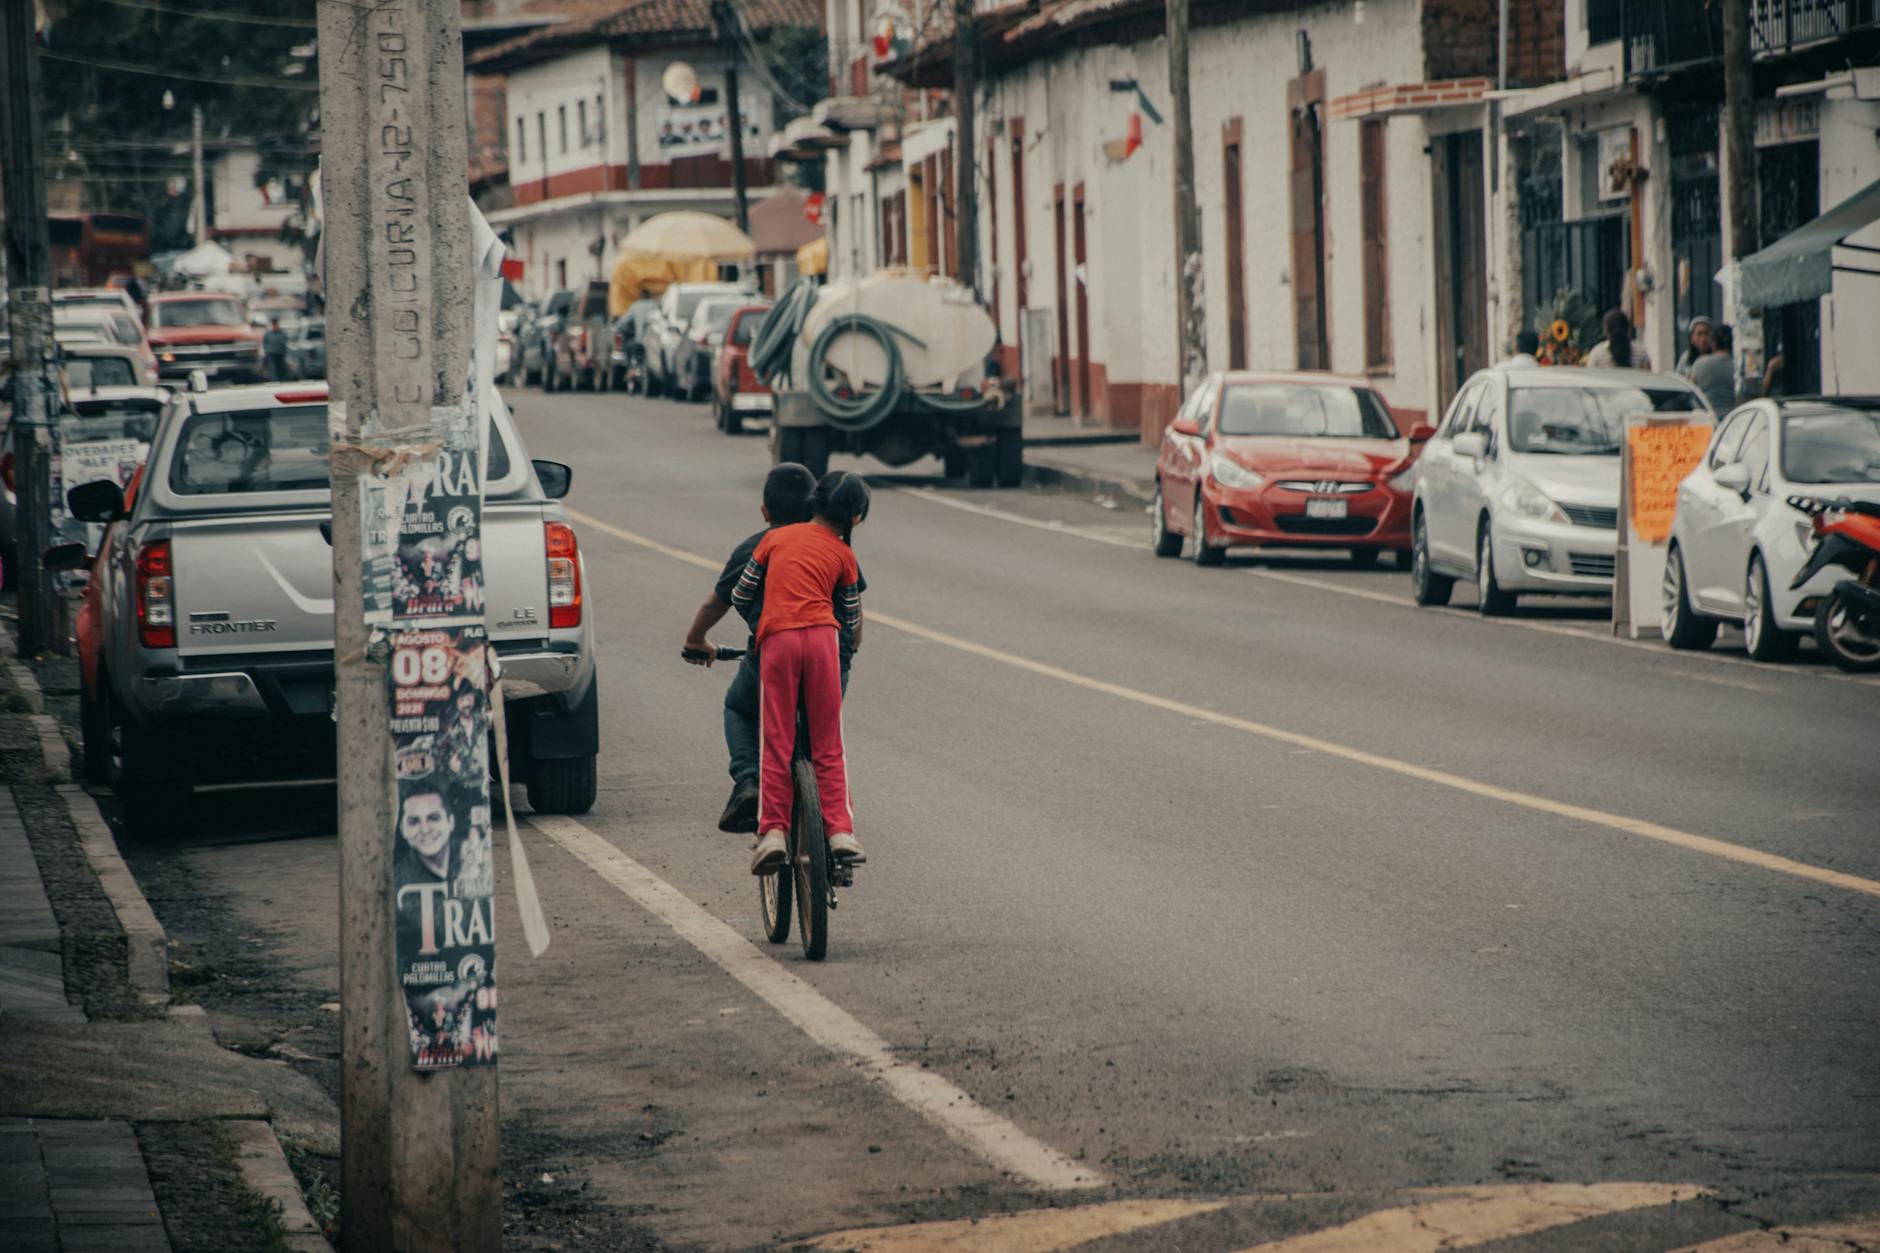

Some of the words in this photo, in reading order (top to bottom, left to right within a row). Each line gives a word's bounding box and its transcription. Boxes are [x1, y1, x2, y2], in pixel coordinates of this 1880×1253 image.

[63, 443, 136, 457] OVEDADES
[399, 522, 444, 534] ALOMILLAS
[512, 606, 536, 619] LE
[189, 619, 278, 635] FRONTIER
[397, 633, 445, 645] AGOSTO
[392, 648, 450, 686] 08
[411, 961, 447, 973] CUATRO
